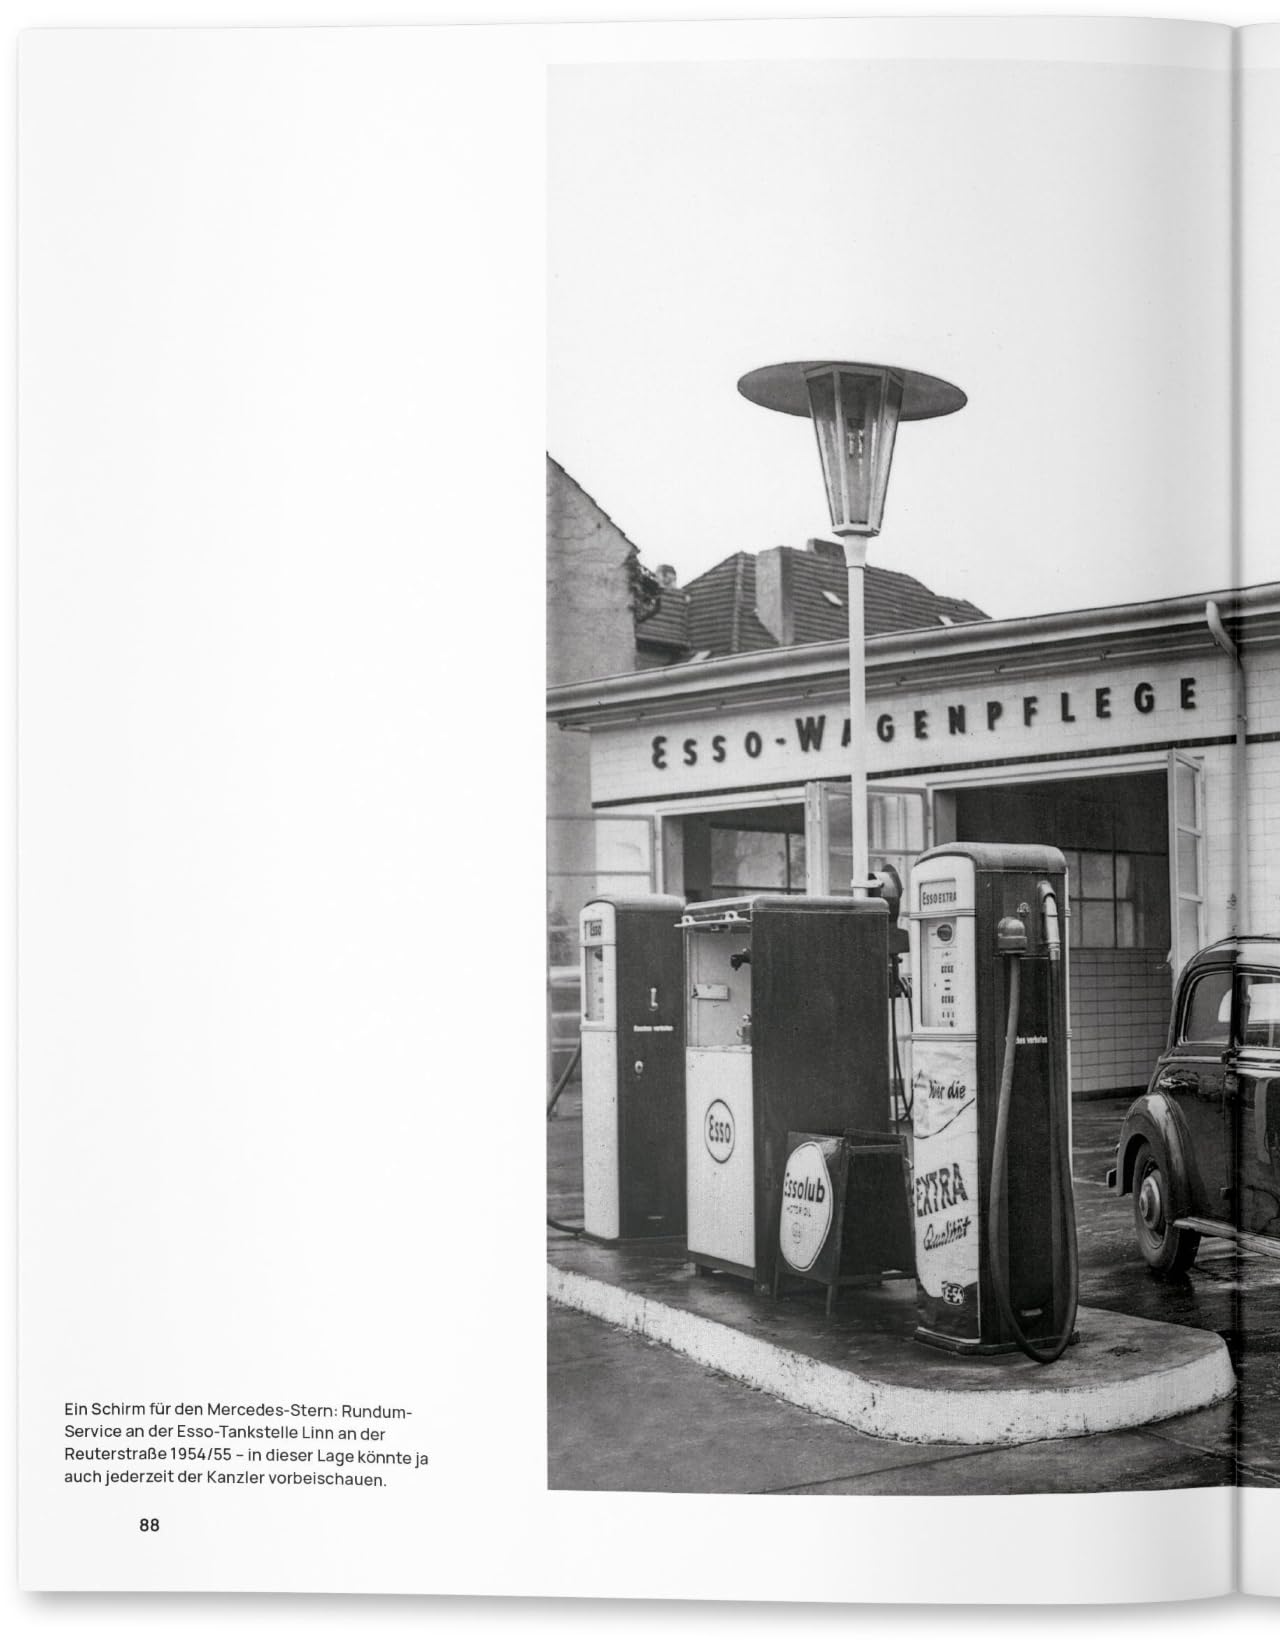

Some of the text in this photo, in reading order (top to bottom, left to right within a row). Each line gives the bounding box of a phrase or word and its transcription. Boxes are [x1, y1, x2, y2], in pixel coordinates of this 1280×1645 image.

[947, 1080, 966, 1099] die
[915, 1162, 969, 1217] EXTRA
[923, 1215, 972, 1250] Qualität
[65, 1402, 412, 1419] Ein Schirm für den Mercedes-Stern: Rundum-
[64, 1424, 386, 1441] Service an der Esso-Tankstelle Linn an der
[65, 1446, 167, 1461] Reuterstraße
[170, 1447, 232, 1462] 1954/55
[248, 1449, 262, 1462] in
[265, 1448, 314, 1462] dieser
[317, 1449, 355, 1466] Lage
[357, 1450, 412, 1465] könnte
[413, 1451, 429, 1469] ja
[64, 1470, 387, 1487] auch jederzeit der Kanzler vorbeischauen.
[139, 1518, 160, 1532] 88
